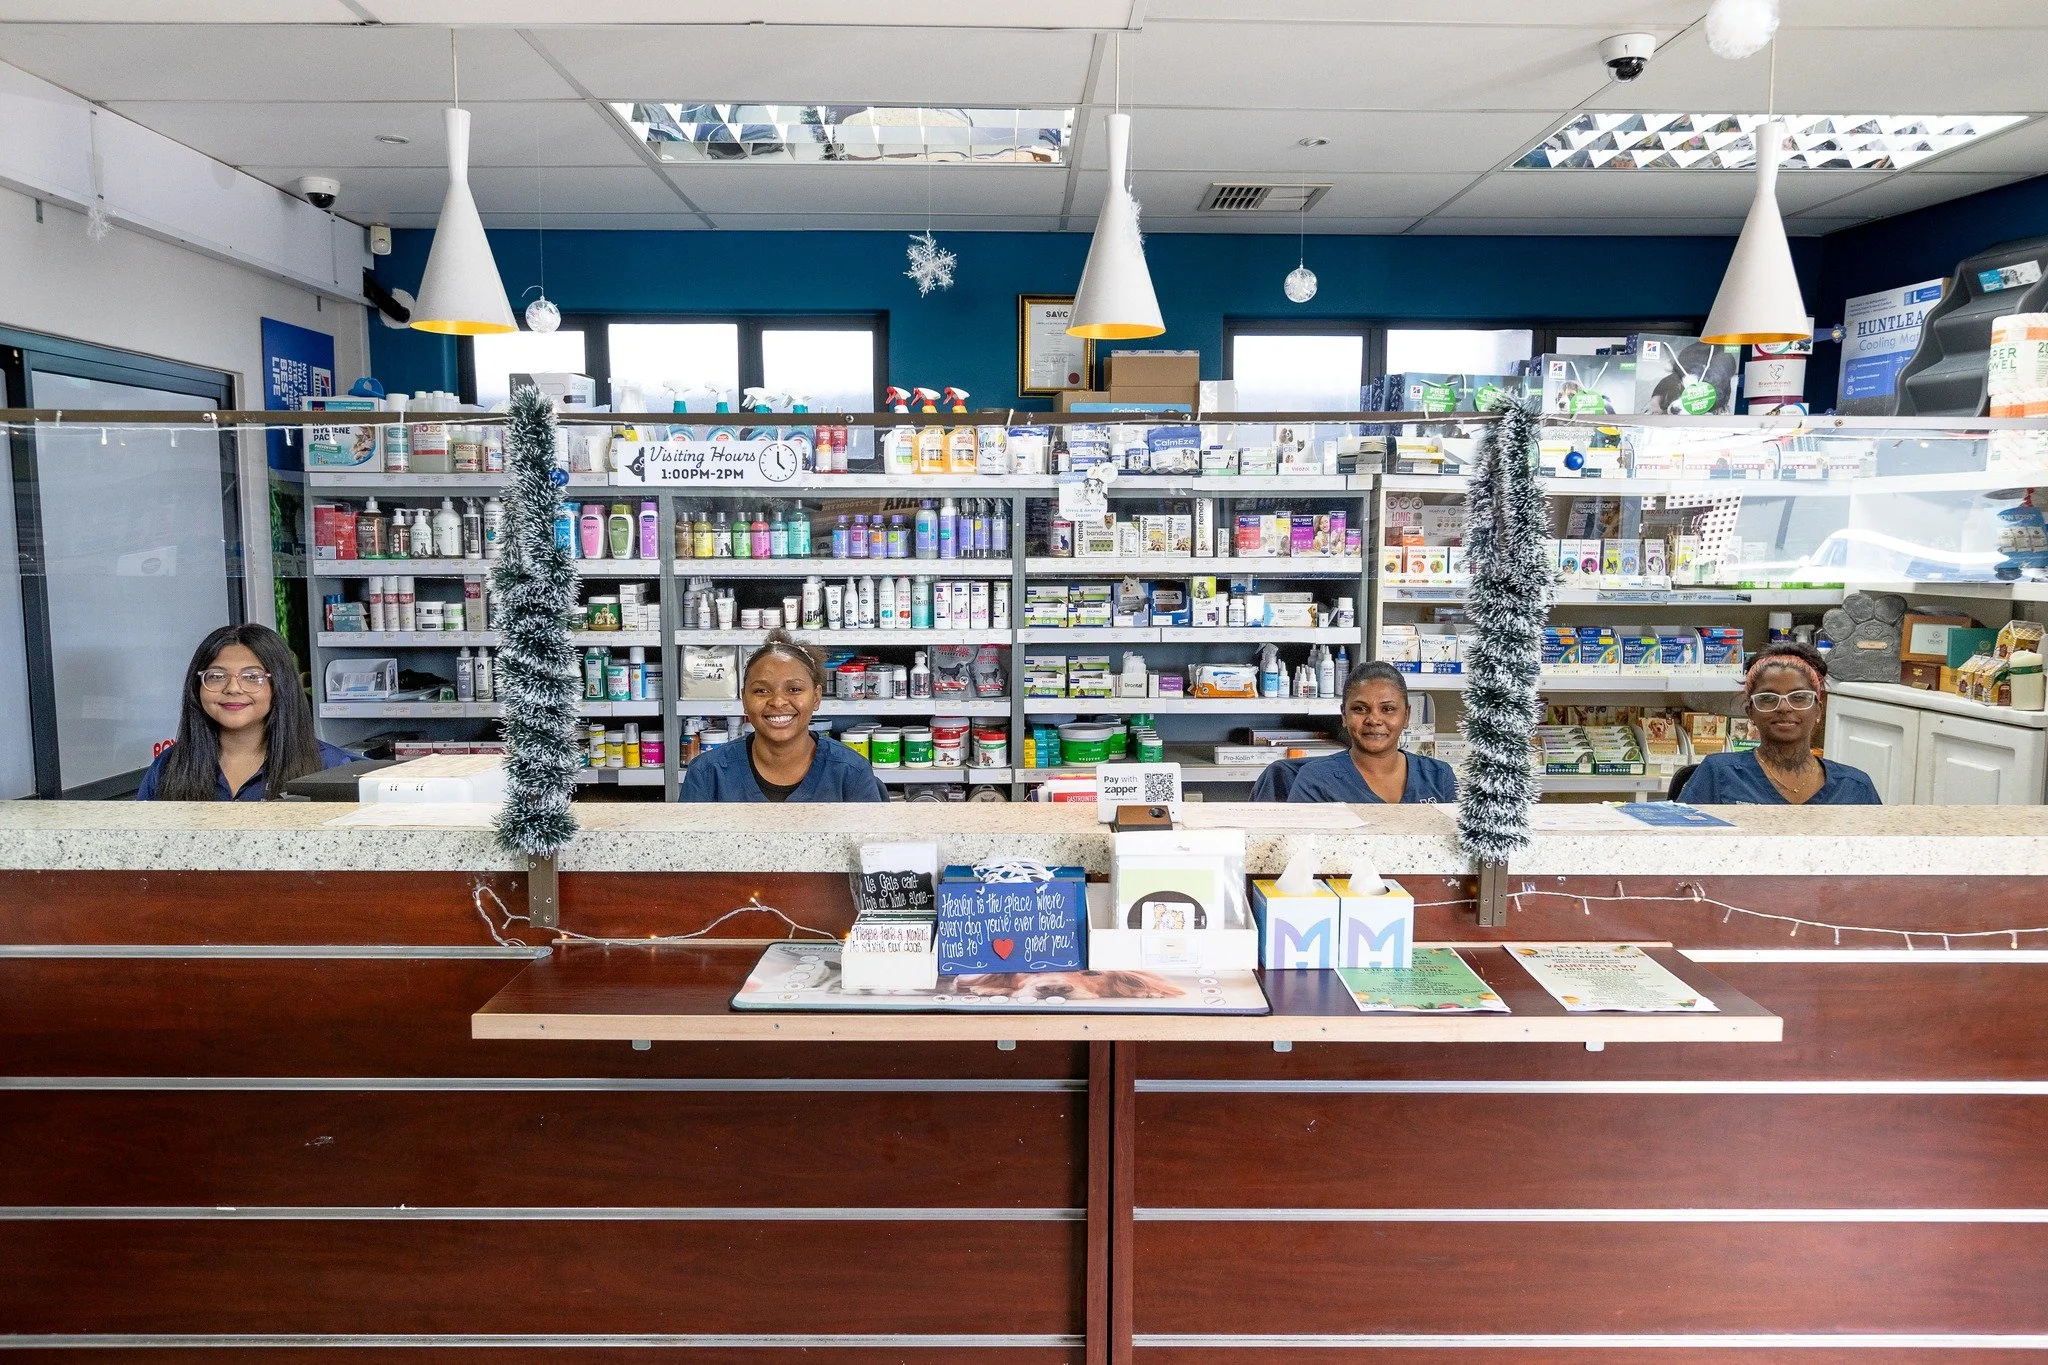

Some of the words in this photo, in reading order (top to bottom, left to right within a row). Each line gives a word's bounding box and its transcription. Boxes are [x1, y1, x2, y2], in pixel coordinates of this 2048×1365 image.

[1045, 310, 1069, 318] SAVC
[1857, 310, 1924, 336] HUNTLEA
[1859, 336, 1896, 351] Cooling
[1901, 332, 1920, 344] Mat
[272, 356, 281, 396] LIFE
[280, 358, 289, 405] BEST
[1154, 438, 1195, 446] CalmEze
[650, 446, 705, 469] Visiting
[711, 446, 756, 463] Hours
[661, 469, 744, 480] 1:00PM-2PM
[1392, 511, 1411, 522] LONG
[1103, 775, 1120, 785] Pay
[1121, 775, 1138, 783] with
[1104, 785, 1138, 796] zapper
[864, 876, 877, 893] Us
[879, 874, 900, 898] Gals
[942, 893, 975, 918] Heaven
[977, 896, 985, 914] is
[985, 892, 1003, 913] the
[1004, 892, 1033, 917] place
[1036, 891, 1065, 914] where
[853, 926, 879, 941] Please
[879, 926, 896, 941] take
[939, 920, 963, 943] every
[964, 916, 983, 945] dog
[985, 914, 1012, 942] you've
[1014, 915, 1034, 932] ever
[941, 941, 964, 959] runs
[966, 937, 978, 958] to
[1024, 932, 1050, 962] greet
[1051, 931, 1075, 957] you!
